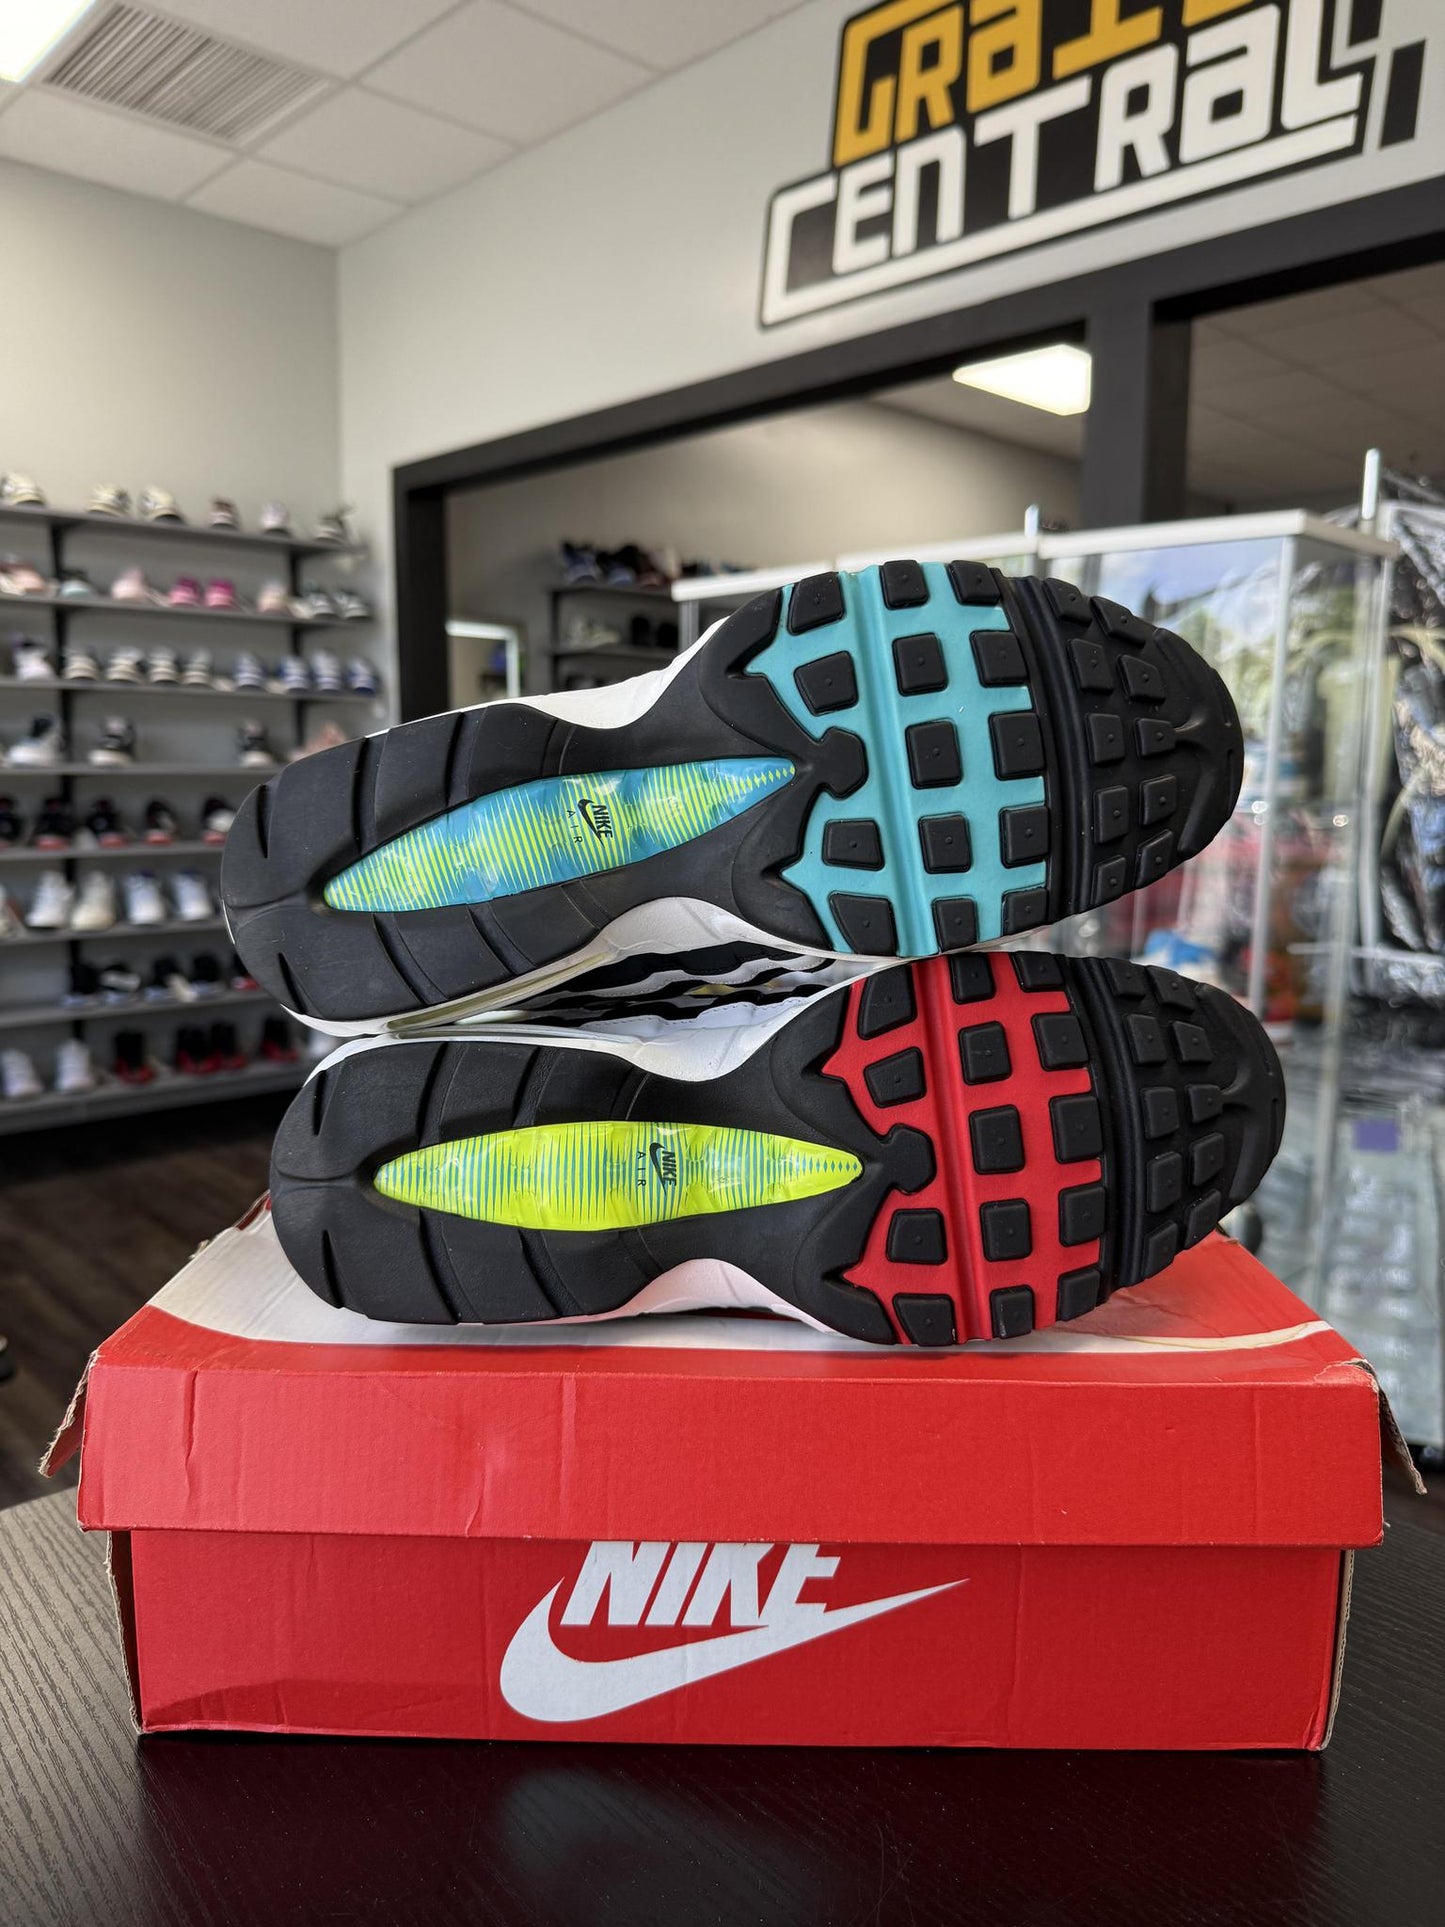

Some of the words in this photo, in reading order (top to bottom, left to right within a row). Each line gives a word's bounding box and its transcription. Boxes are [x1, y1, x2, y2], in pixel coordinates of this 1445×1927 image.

[566, 809, 584, 844] AIR
[591, 804, 614, 839] NIKE
[637, 1150, 647, 1187] AIR
[661, 1150, 677, 1187] NIKE
[559, 1541, 842, 1627] NIKE
